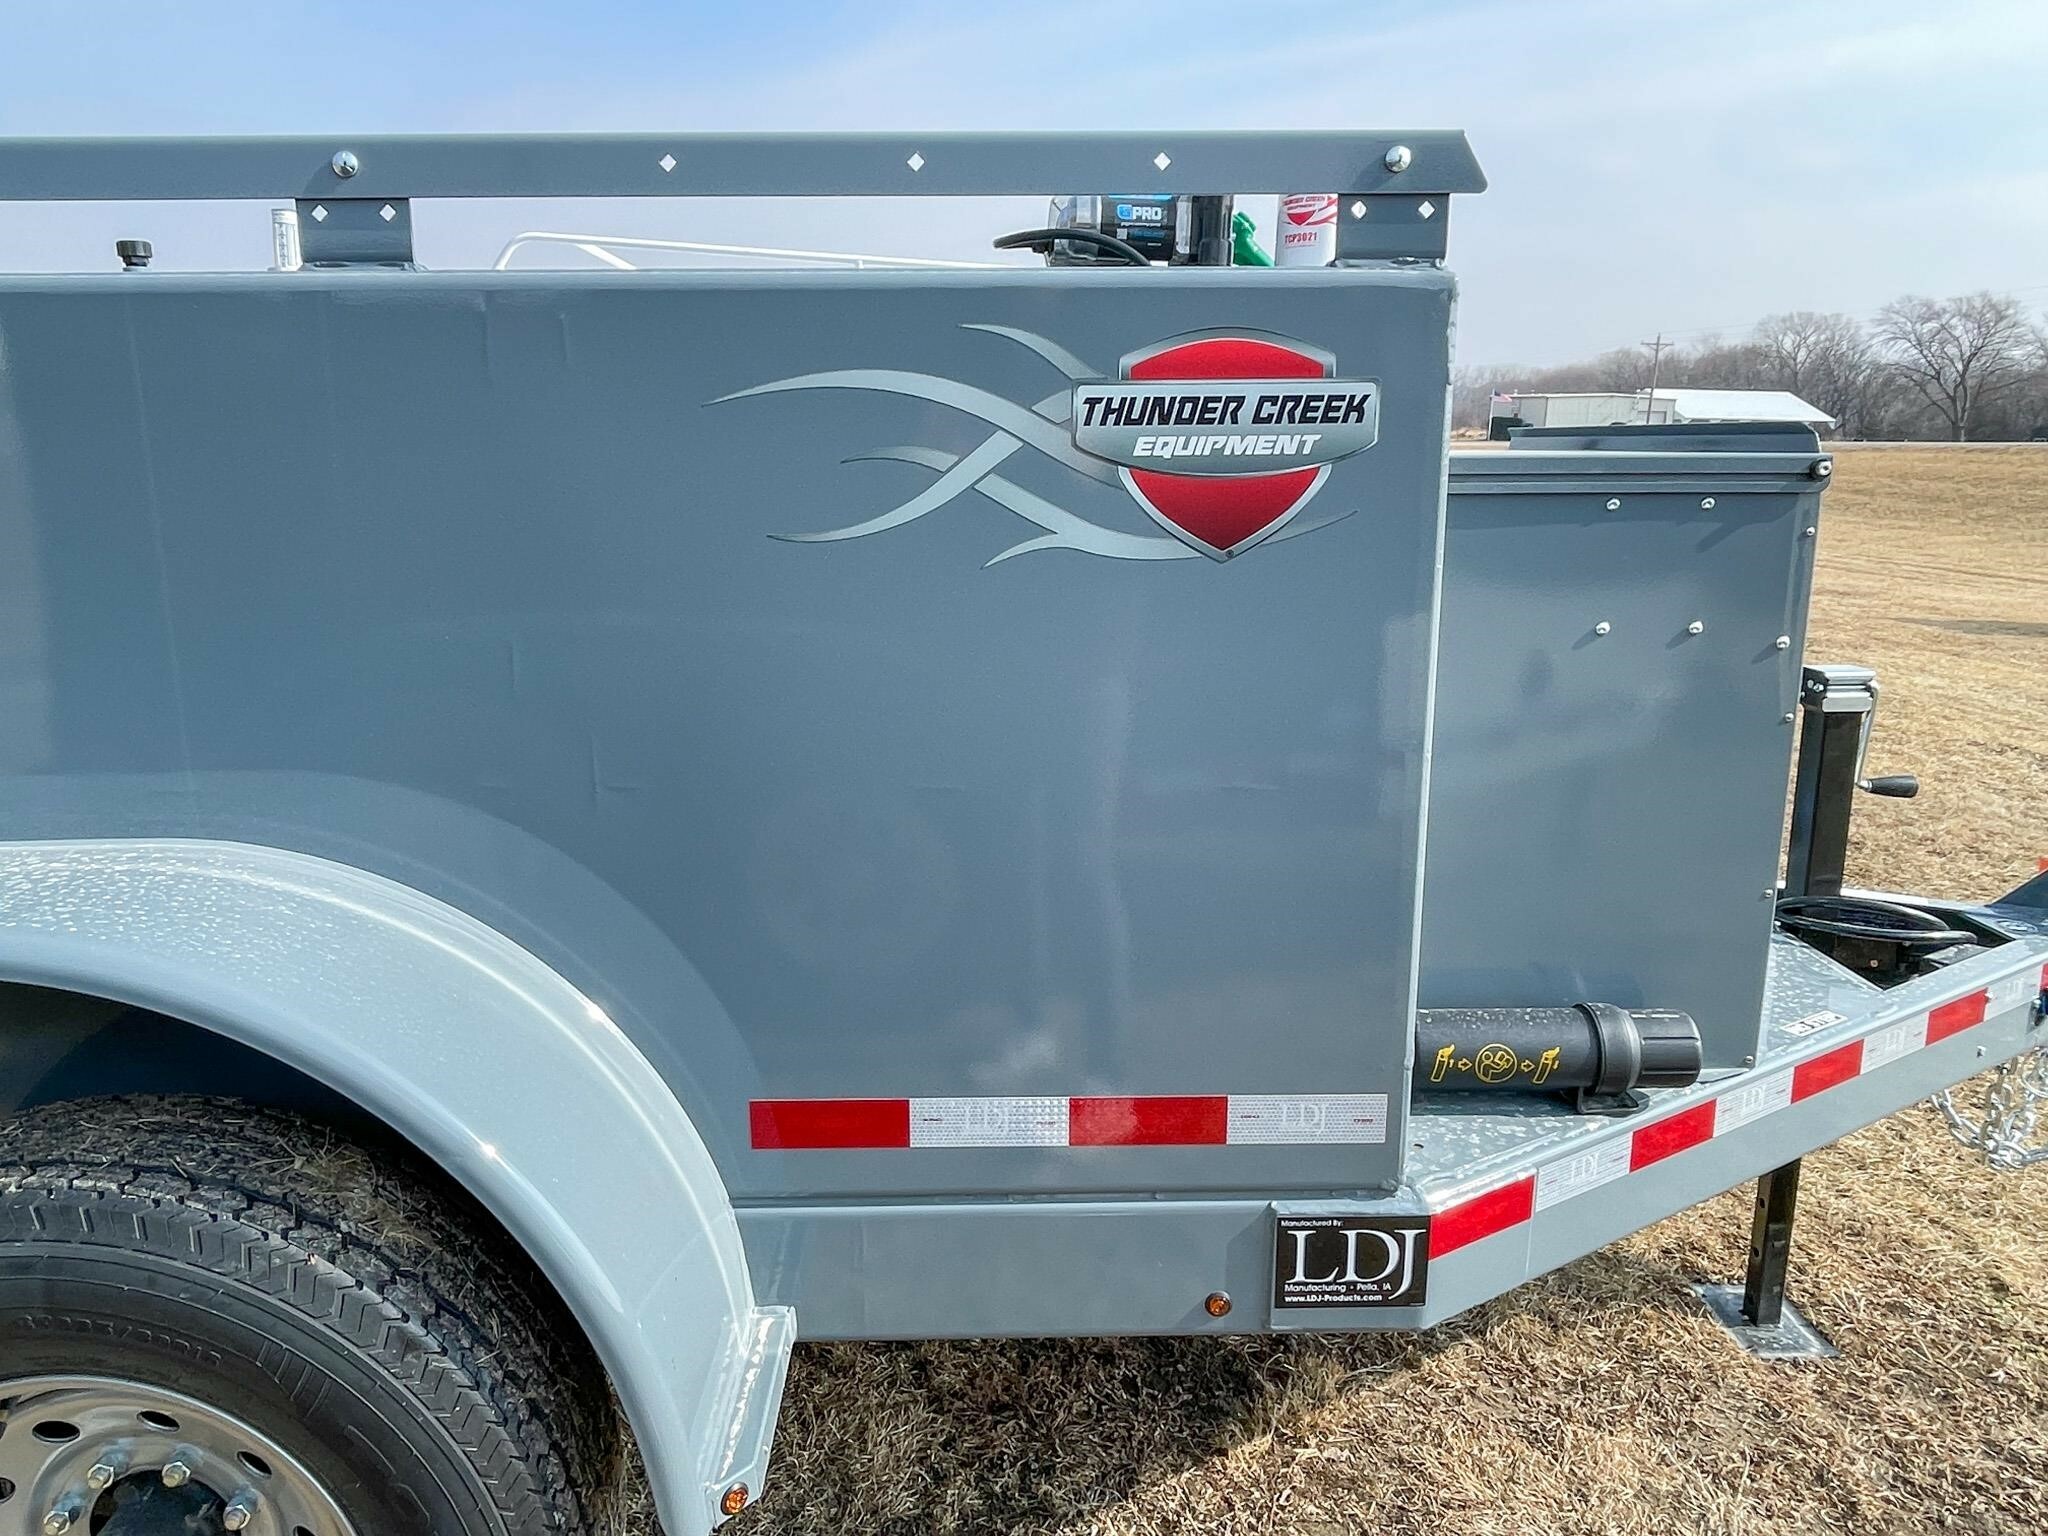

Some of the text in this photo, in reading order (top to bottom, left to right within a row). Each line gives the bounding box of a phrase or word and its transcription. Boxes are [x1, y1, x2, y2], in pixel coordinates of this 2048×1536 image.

[1082, 394, 1371, 426] THUNDER CREEK
[1132, 434, 1322, 459] EQUIPMENT
[1286, 1229, 1427, 1300] LDJ
[1284, 1284, 1347, 1293] Manufacturing
[1284, 1294, 1383, 1302] www.LDJ-Products.com
